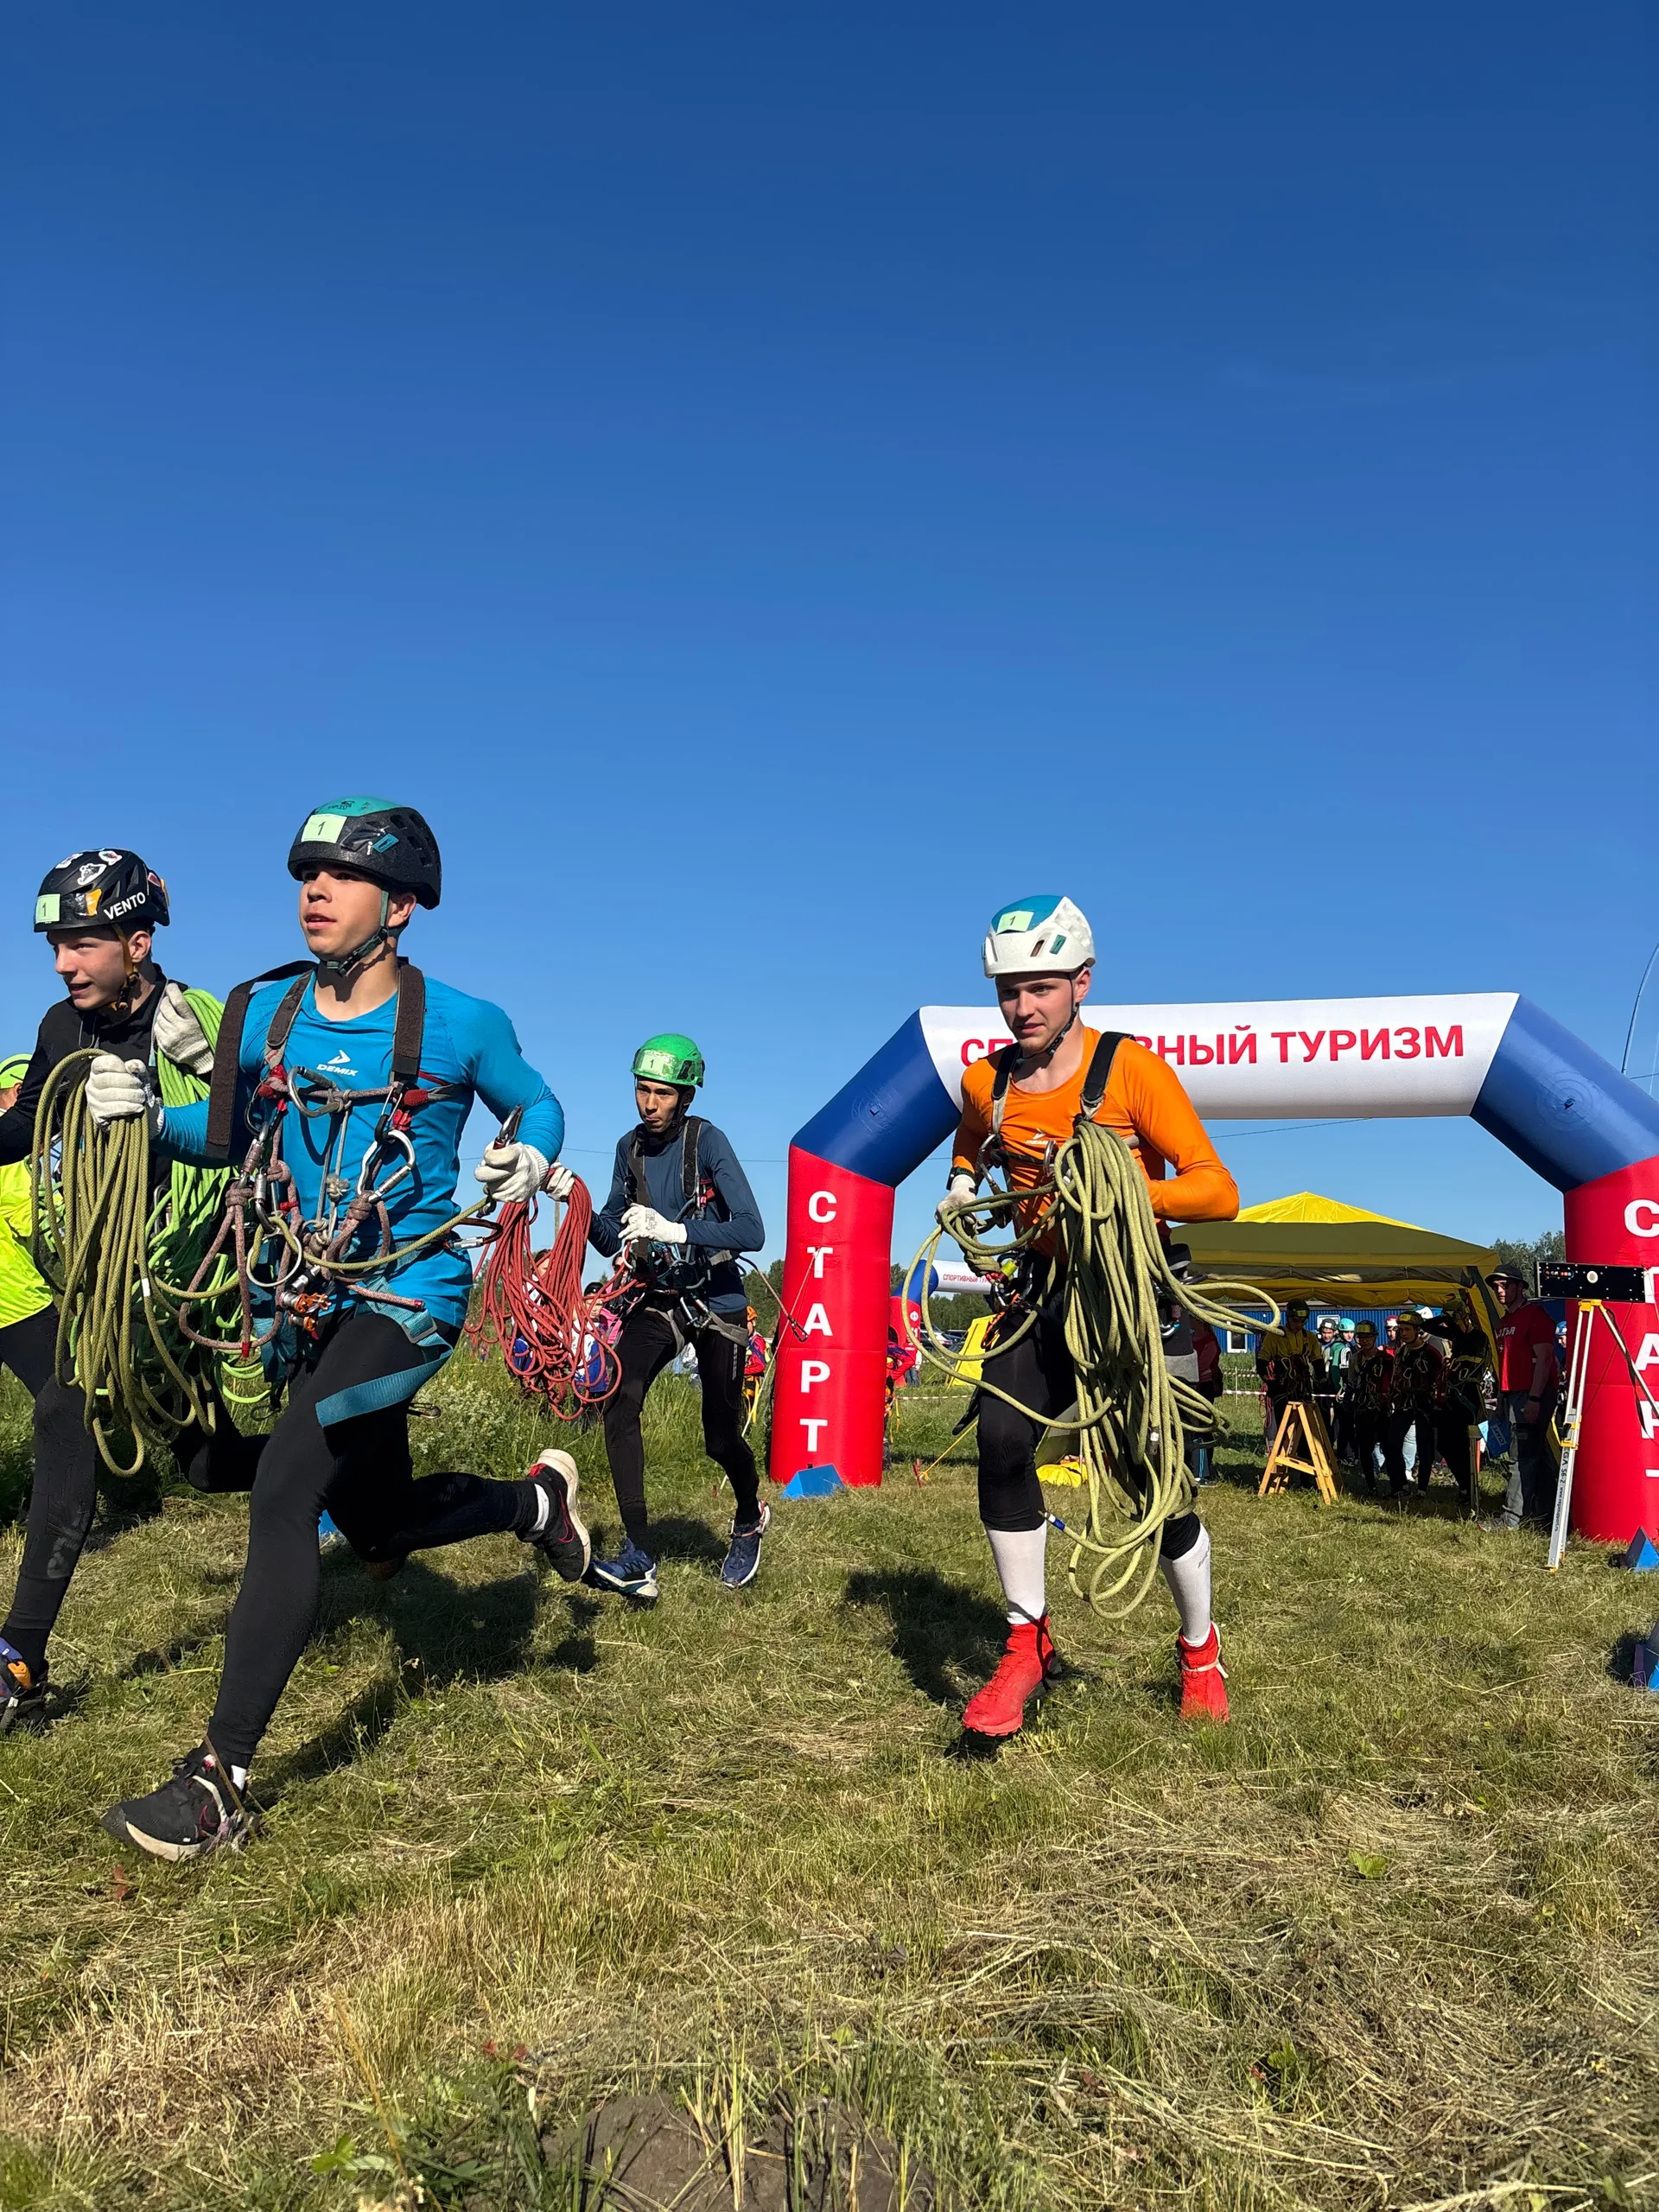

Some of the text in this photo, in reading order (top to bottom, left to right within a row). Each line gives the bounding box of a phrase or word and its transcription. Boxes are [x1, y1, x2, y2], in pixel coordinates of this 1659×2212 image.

[317, 821, 326, 836] 1
[41, 902, 47, 917] 1
[103, 892, 146, 920] VENTO
[1009, 915, 1016, 926] 1
[961, 1025, 1464, 1067] СПНЫЙ ТУРИЗМ
[316, 1064, 359, 1077] DEMIX
[798, 1190, 838, 1452] СТАРТ
